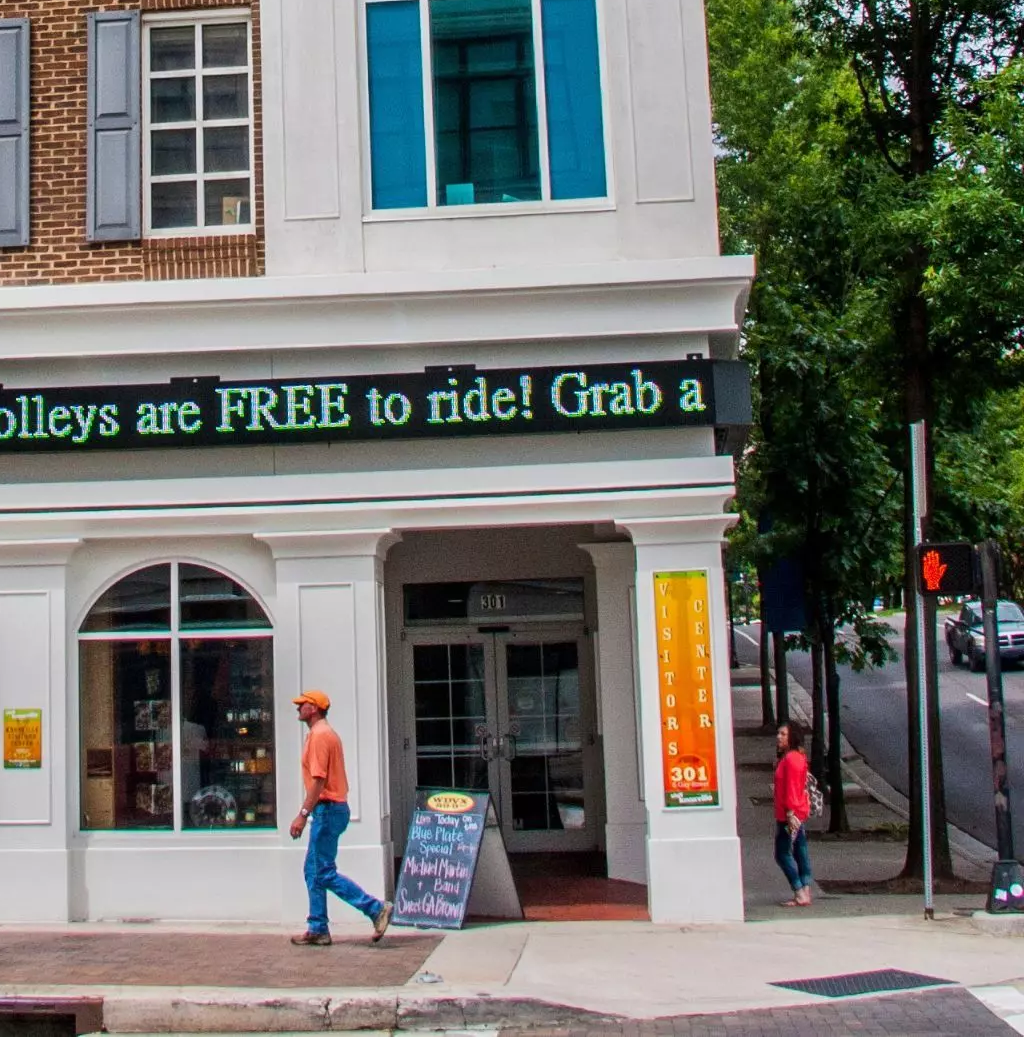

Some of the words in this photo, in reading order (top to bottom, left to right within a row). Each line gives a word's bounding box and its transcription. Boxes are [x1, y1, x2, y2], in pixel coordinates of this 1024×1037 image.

[136, 401, 202, 435] are
[215, 383, 351, 433] FREE
[366, 387, 412, 427] to
[426, 374, 534, 424] ride!
[551, 369, 664, 418] Grab
[679, 378, 707, 413] a
[482, 594, 504, 609] 301
[659, 583, 679, 757] VISITORS
[693, 600, 711, 728] CENTER
[671, 766, 708, 782] 301
[435, 814, 459, 828] Today
[411, 826, 432, 840] Blue
[435, 826, 464, 842] Plate
[420, 840, 453, 857] Special
[434, 878, 460, 895] Band
